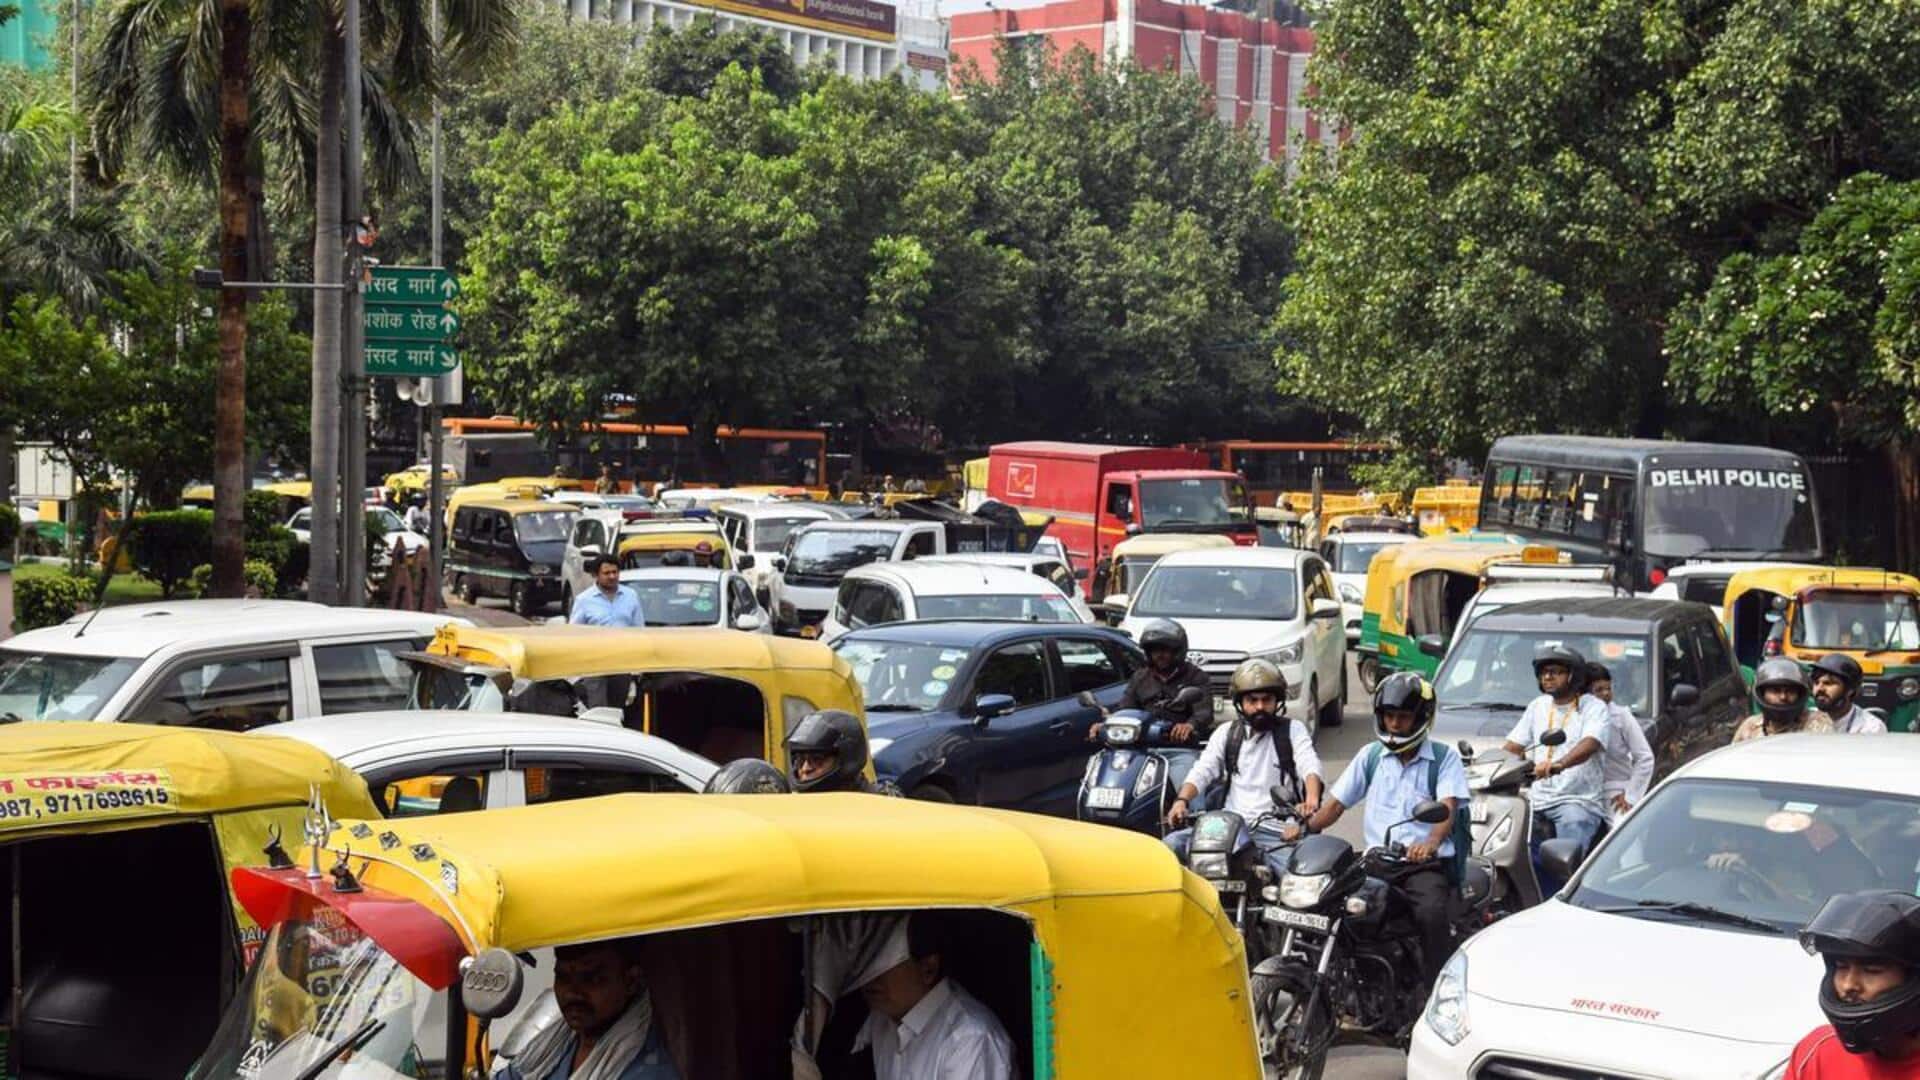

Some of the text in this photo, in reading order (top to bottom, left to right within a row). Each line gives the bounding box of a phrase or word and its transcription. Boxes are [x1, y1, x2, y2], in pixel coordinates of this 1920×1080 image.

[408, 273, 437, 294] मार्ग
[411, 308, 437, 329] रोड
[407, 345, 435, 366] मार्ग
[1651, 469, 1805, 490] DELHI POLICE
[45, 787, 169, 814] 9717698615
[1570, 998, 1661, 1020] भारत सरकार
